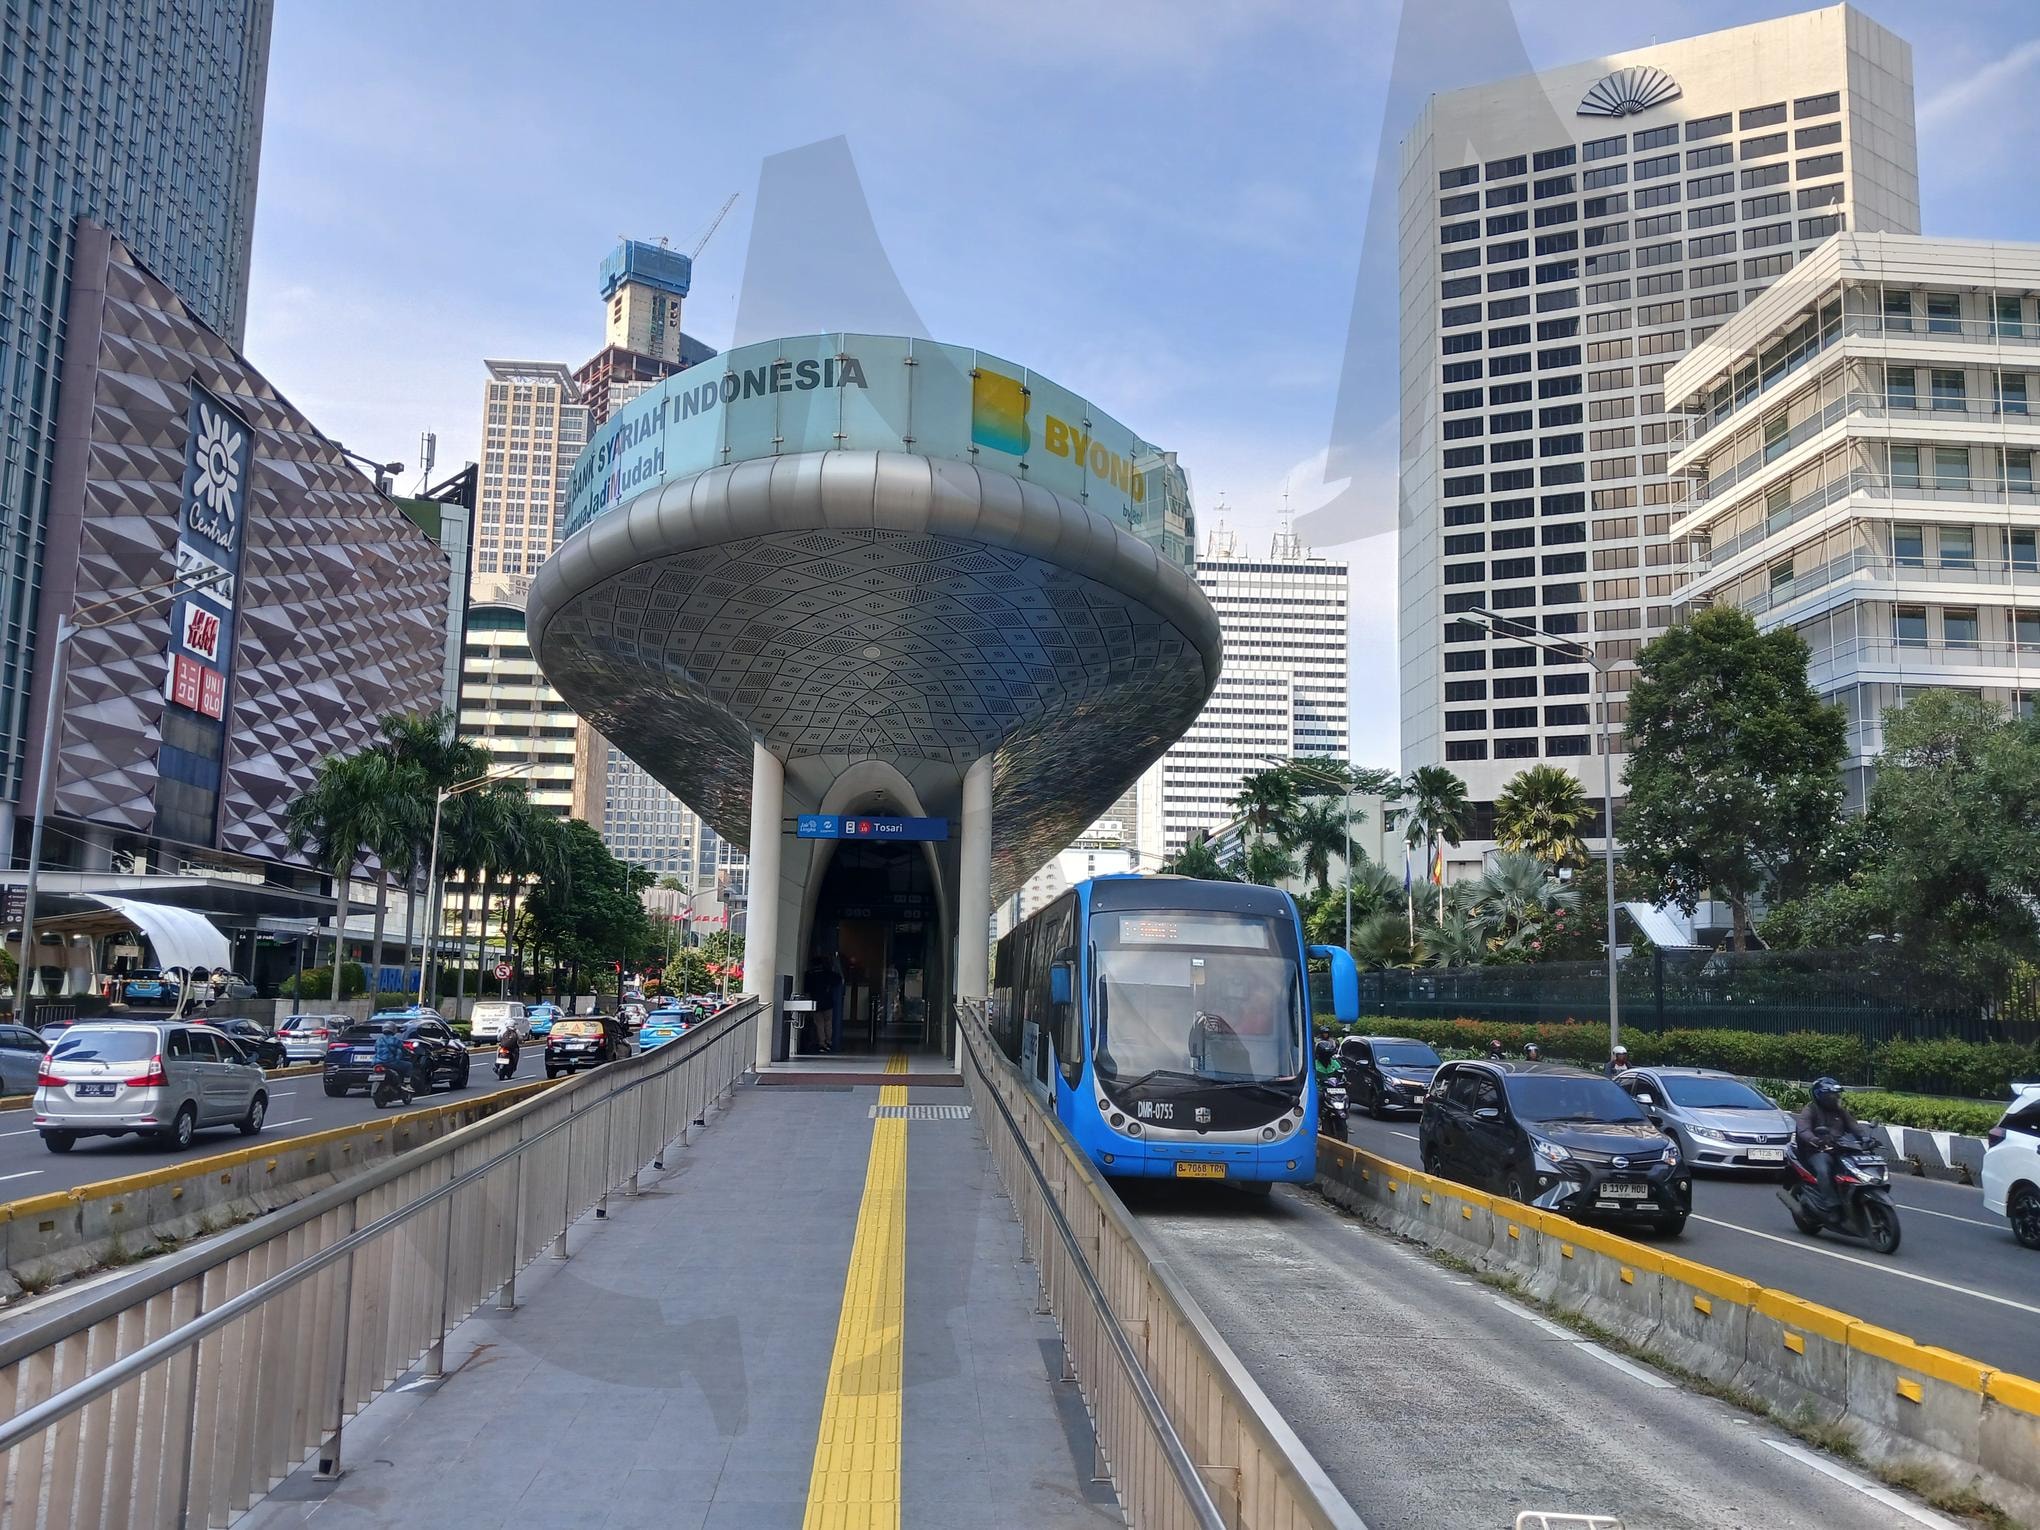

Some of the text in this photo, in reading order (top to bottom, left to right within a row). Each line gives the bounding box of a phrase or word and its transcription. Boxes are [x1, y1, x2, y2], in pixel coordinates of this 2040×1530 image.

[572, 358, 868, 502] BANK SYARIAH INDONESIA
[1045, 414, 1144, 503] BYOND
[189, 501, 235, 552] Central
[205, 674, 221, 694] UNI
[204, 693, 220, 711] QLO
[874, 823, 903, 833] Tosari
[1137, 1101, 1174, 1119] DMR-0755
